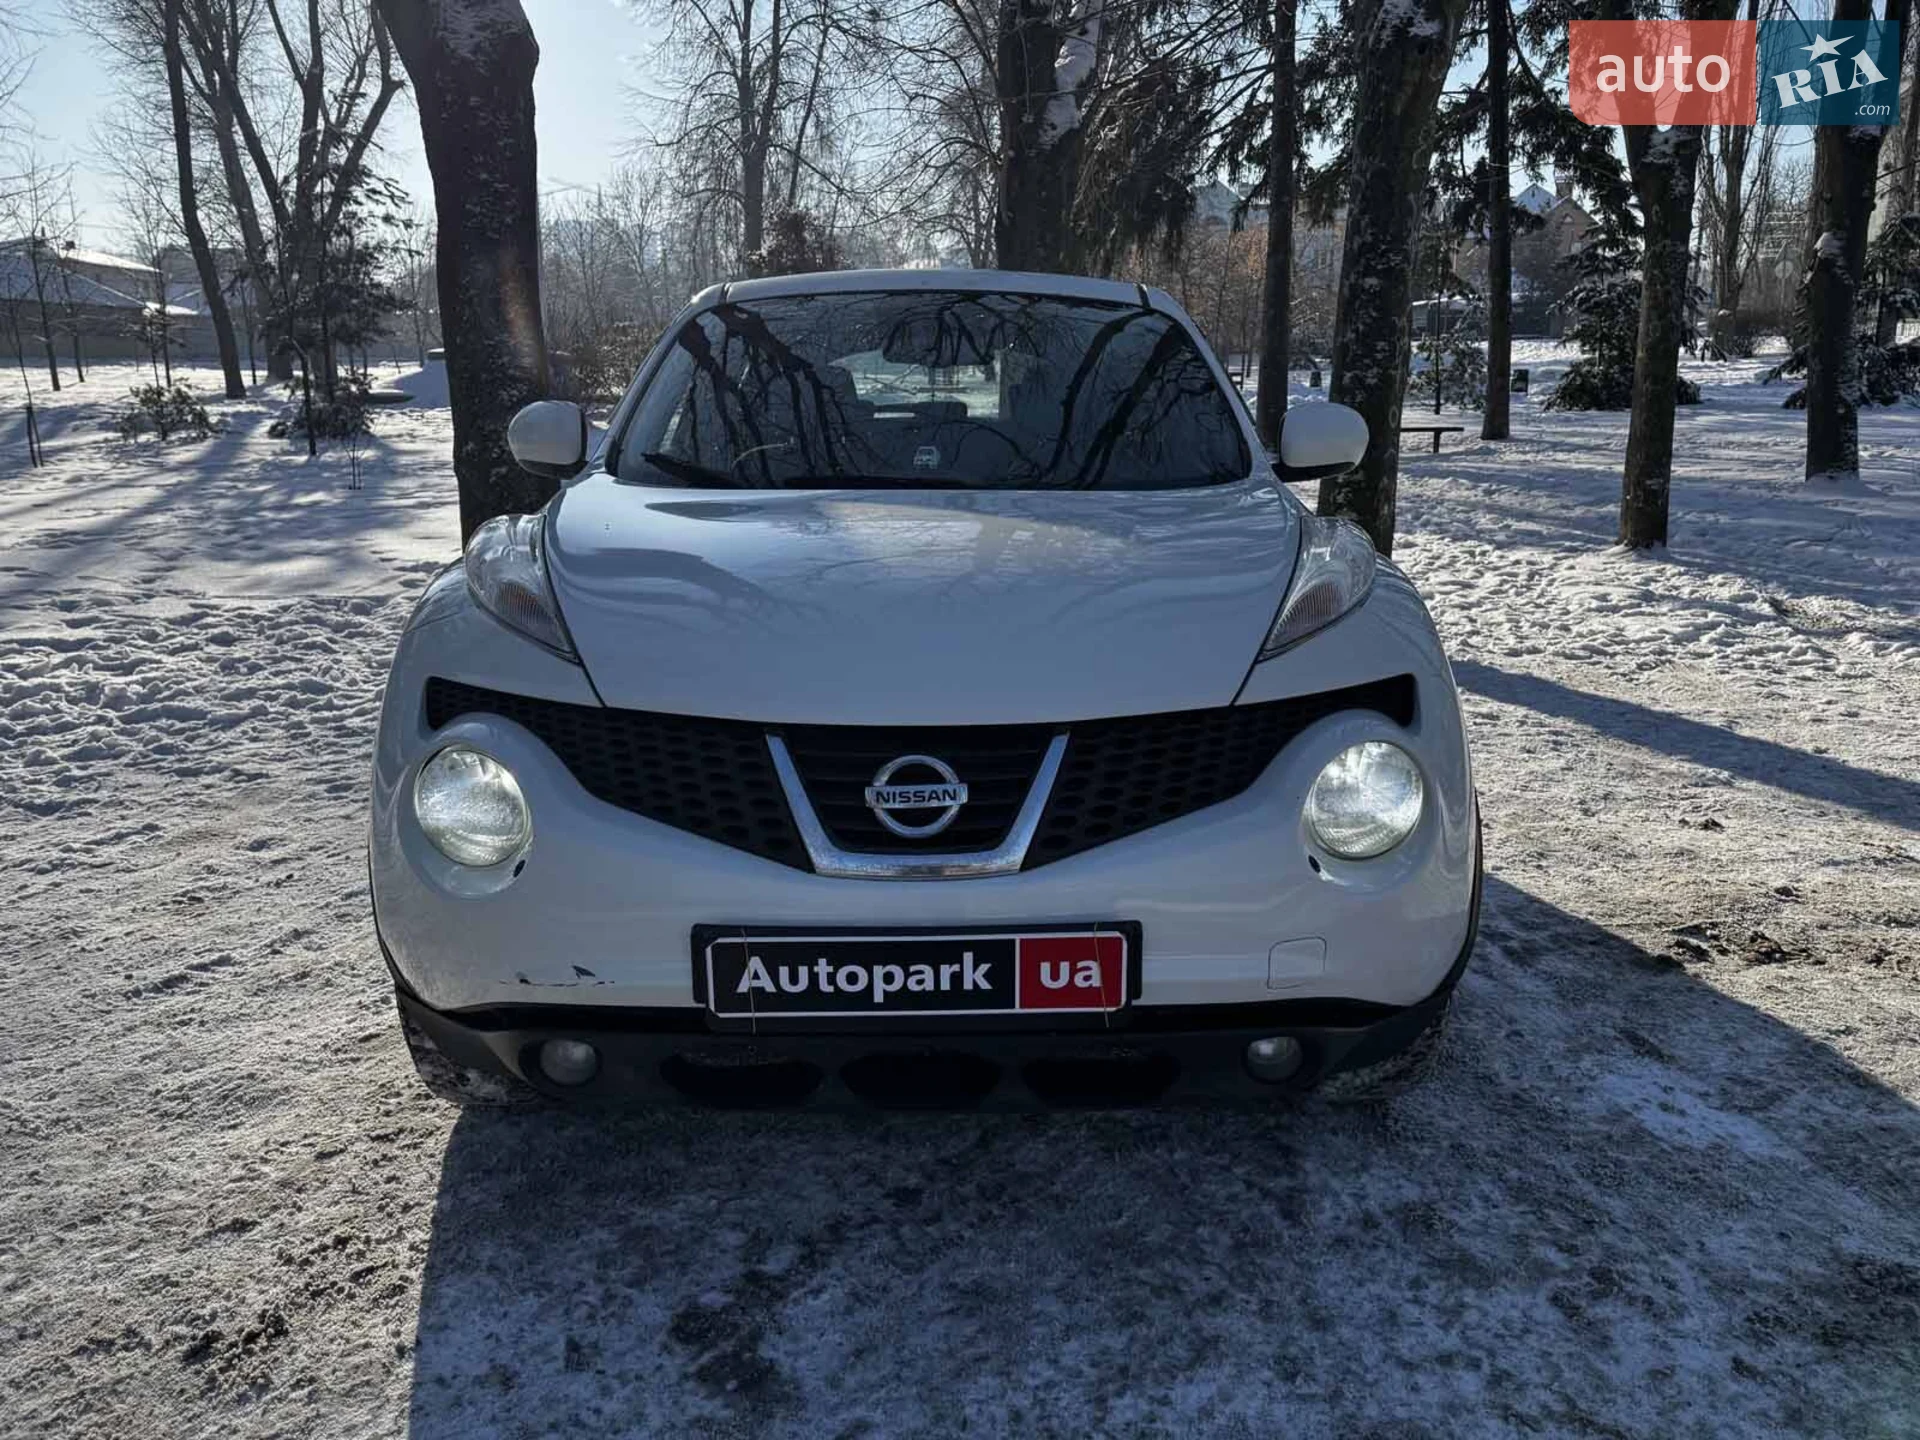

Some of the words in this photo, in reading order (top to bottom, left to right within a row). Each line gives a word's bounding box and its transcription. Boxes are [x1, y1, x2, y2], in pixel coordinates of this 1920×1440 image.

[875, 788, 957, 804] NISSAN
[736, 952, 993, 1003] Autopark
[1039, 960, 1102, 989] ua
